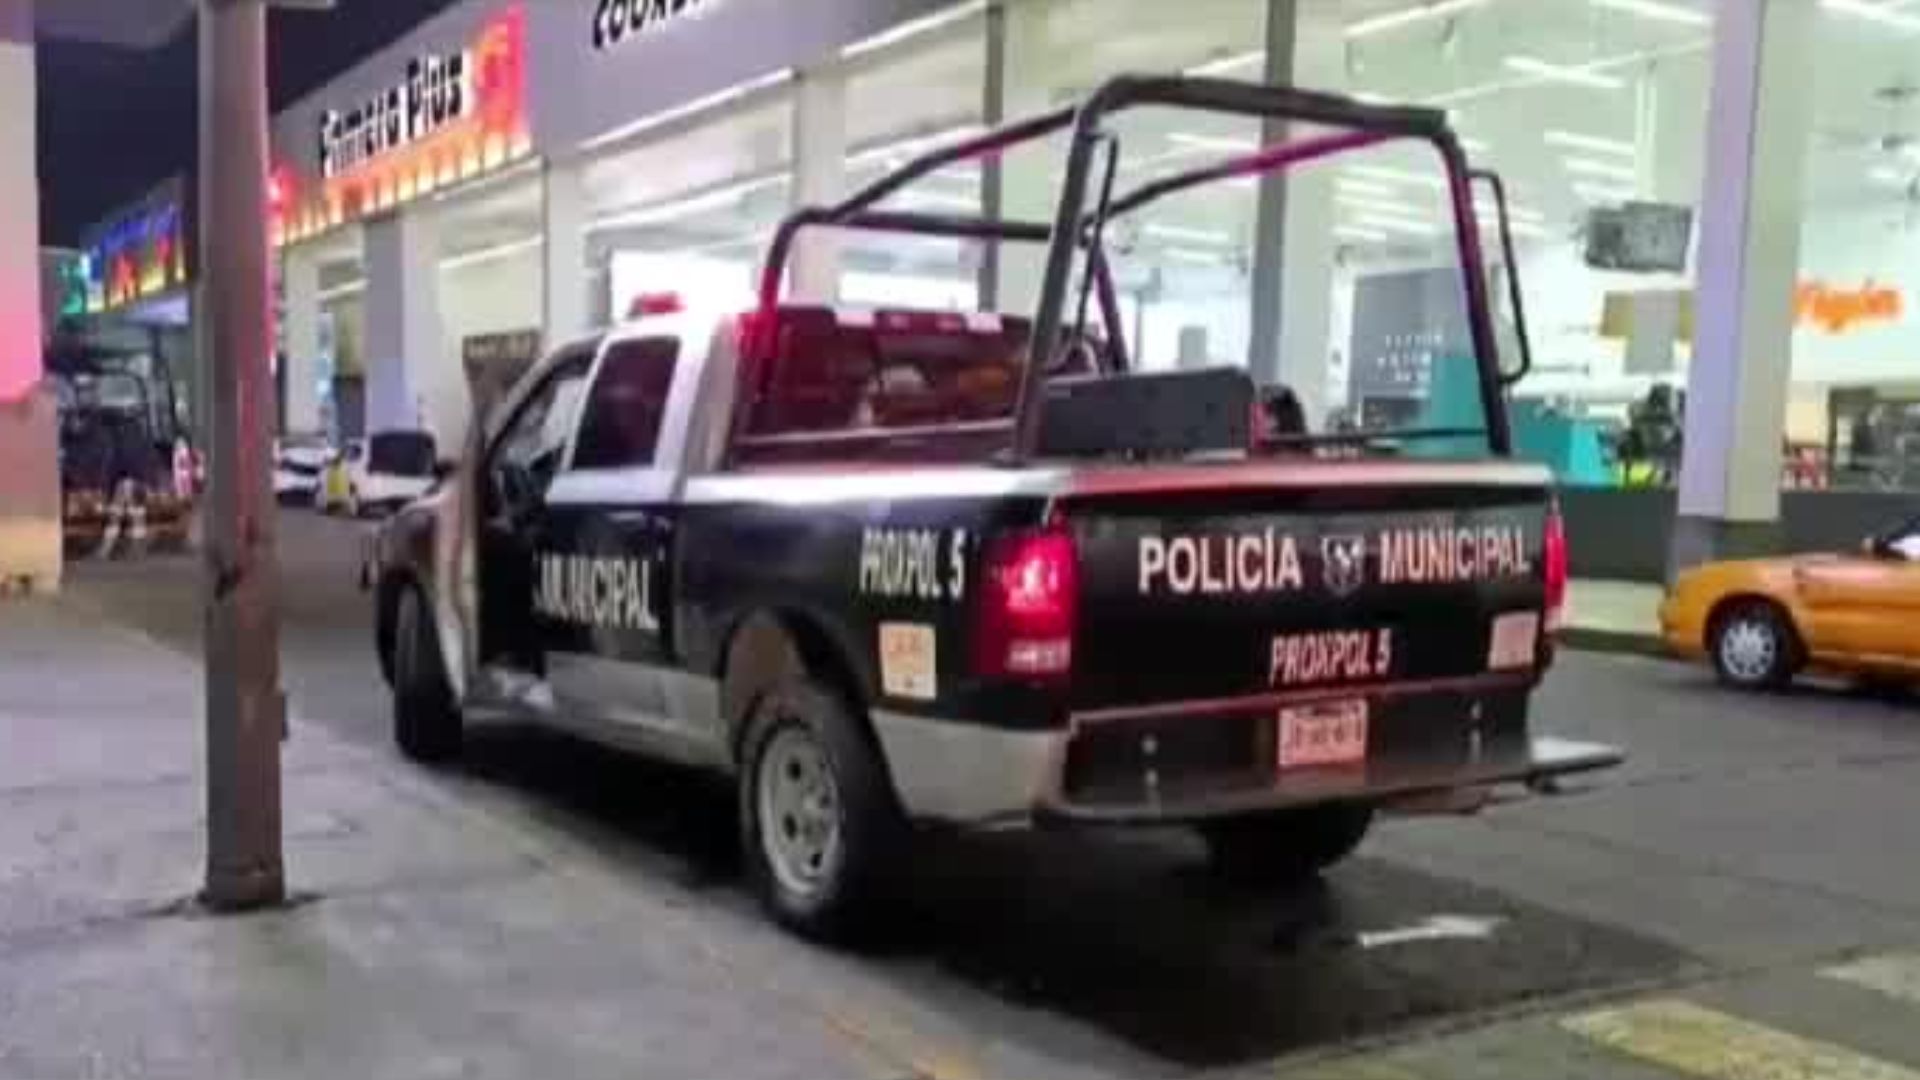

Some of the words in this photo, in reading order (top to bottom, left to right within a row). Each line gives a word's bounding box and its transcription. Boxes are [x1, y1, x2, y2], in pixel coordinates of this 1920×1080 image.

[407, 57, 464, 140] Plus
[860, 526, 941, 598] PROXPOL
[950, 527, 967, 599] 5
[1138, 526, 1302, 593] POLICÍA
[1379, 526, 1530, 584] MUNICIPAL
[1269, 631, 1371, 687] PROXPOL
[1375, 628, 1392, 675] 5
